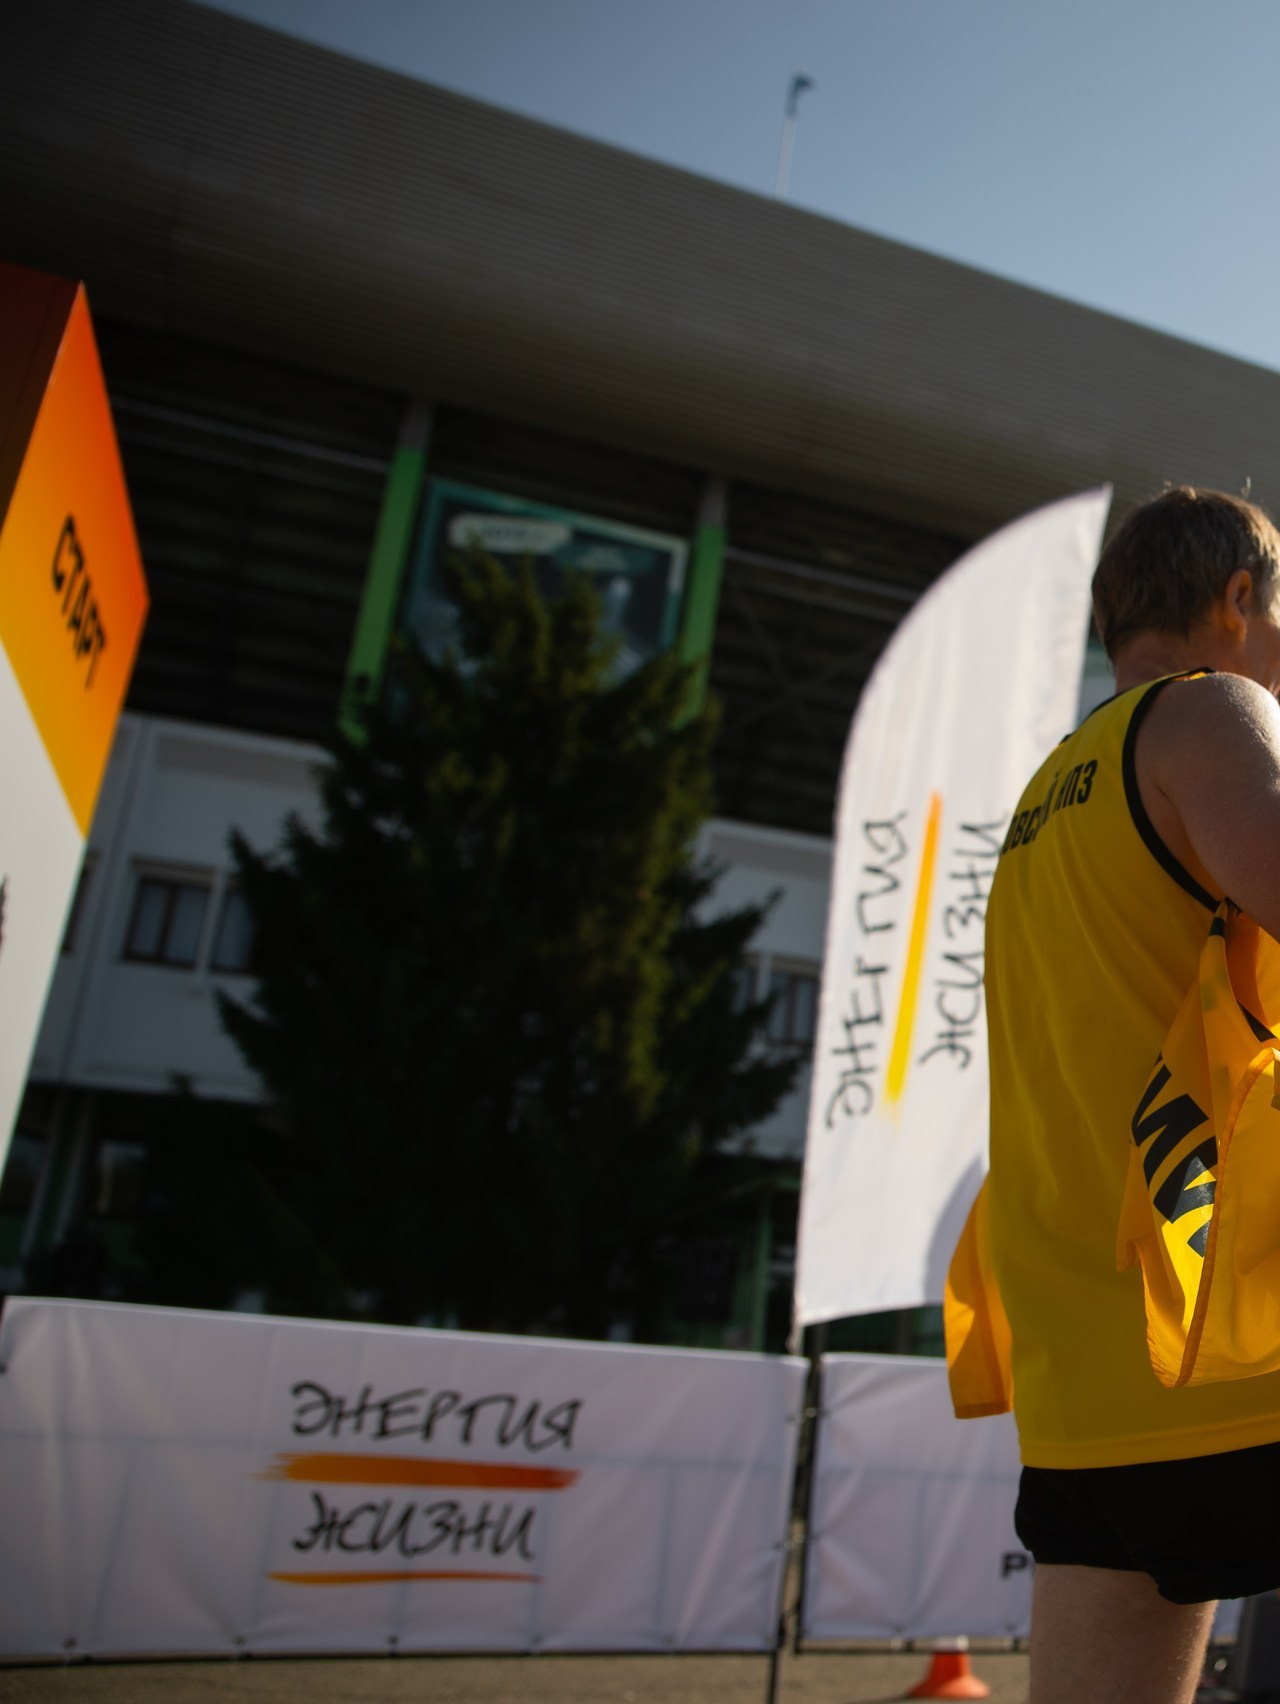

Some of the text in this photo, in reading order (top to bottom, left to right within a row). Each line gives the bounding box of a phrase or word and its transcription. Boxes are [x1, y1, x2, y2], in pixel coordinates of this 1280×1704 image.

[51, 514, 107, 690] СТАРТ
[826, 811, 908, 1131] ЭНЕРГИЯ
[918, 811, 1008, 1070] ЖИЗНИ
[290, 1380, 583, 1453] ЭНЕРГИЯ
[291, 1491, 536, 1560] ЖИЗНИ
